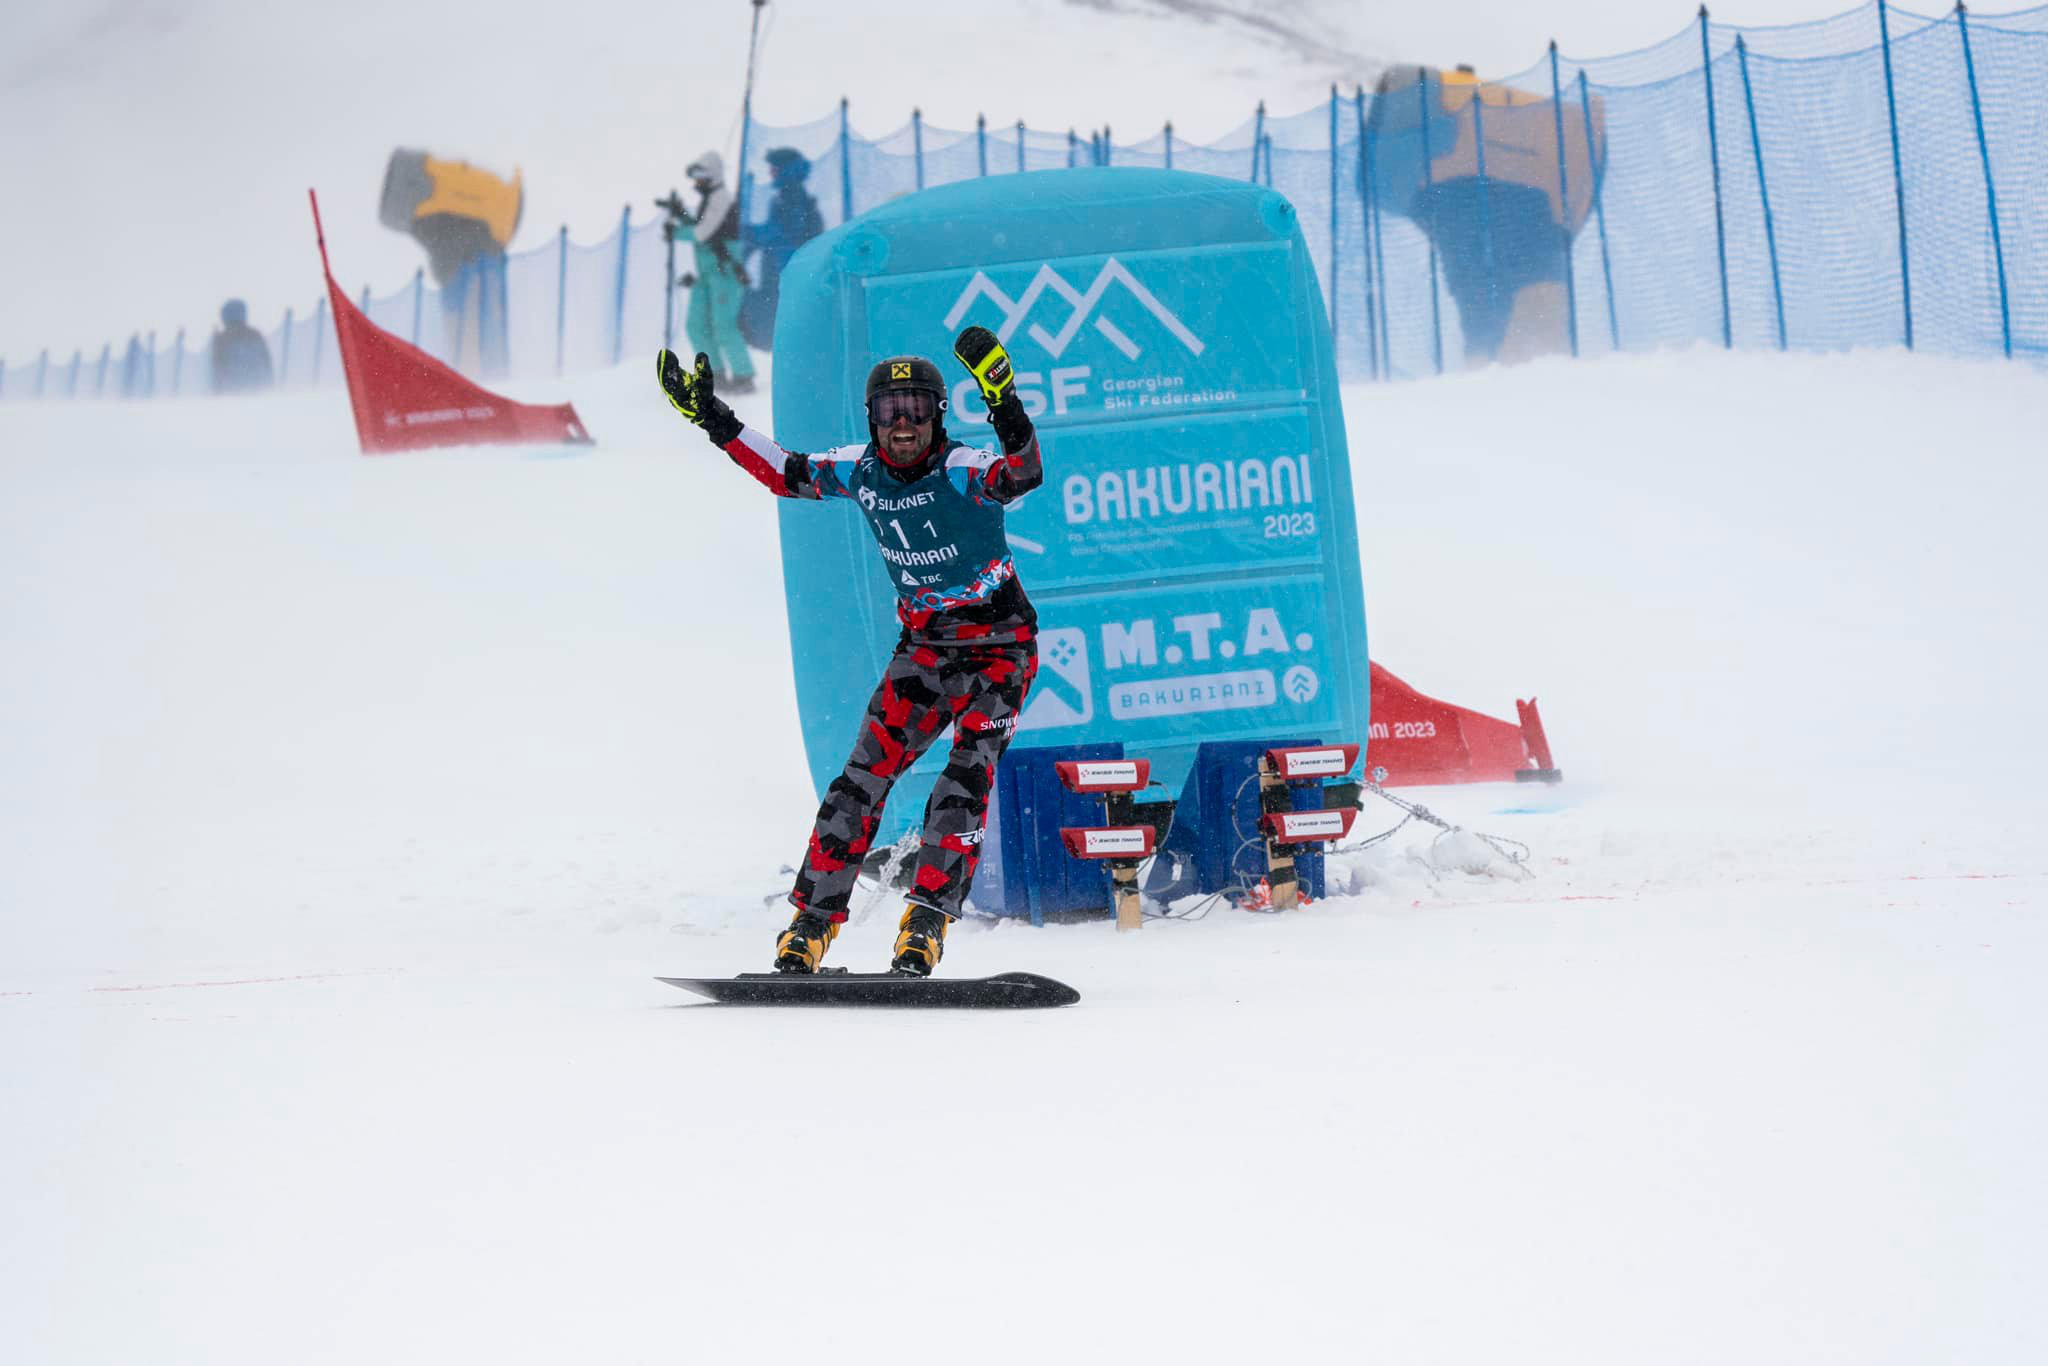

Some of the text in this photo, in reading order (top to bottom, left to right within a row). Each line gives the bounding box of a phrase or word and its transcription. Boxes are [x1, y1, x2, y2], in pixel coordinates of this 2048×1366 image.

[1103, 375, 1184, 392] Georgian
[1103, 389, 1237, 409] Ski Federation
[1063, 454, 1313, 524] BAKURIANI
[878, 491, 935, 511] SILKNET
[889, 519, 911, 549] 1
[923, 519, 938, 538] 1
[1263, 512, 1316, 538] 2023
[920, 573, 943, 585] TBC
[1101, 607, 1313, 670] M.T.A.
[1120, 680, 1266, 708] BAKURIANI
[1394, 720, 1437, 738] 2023
